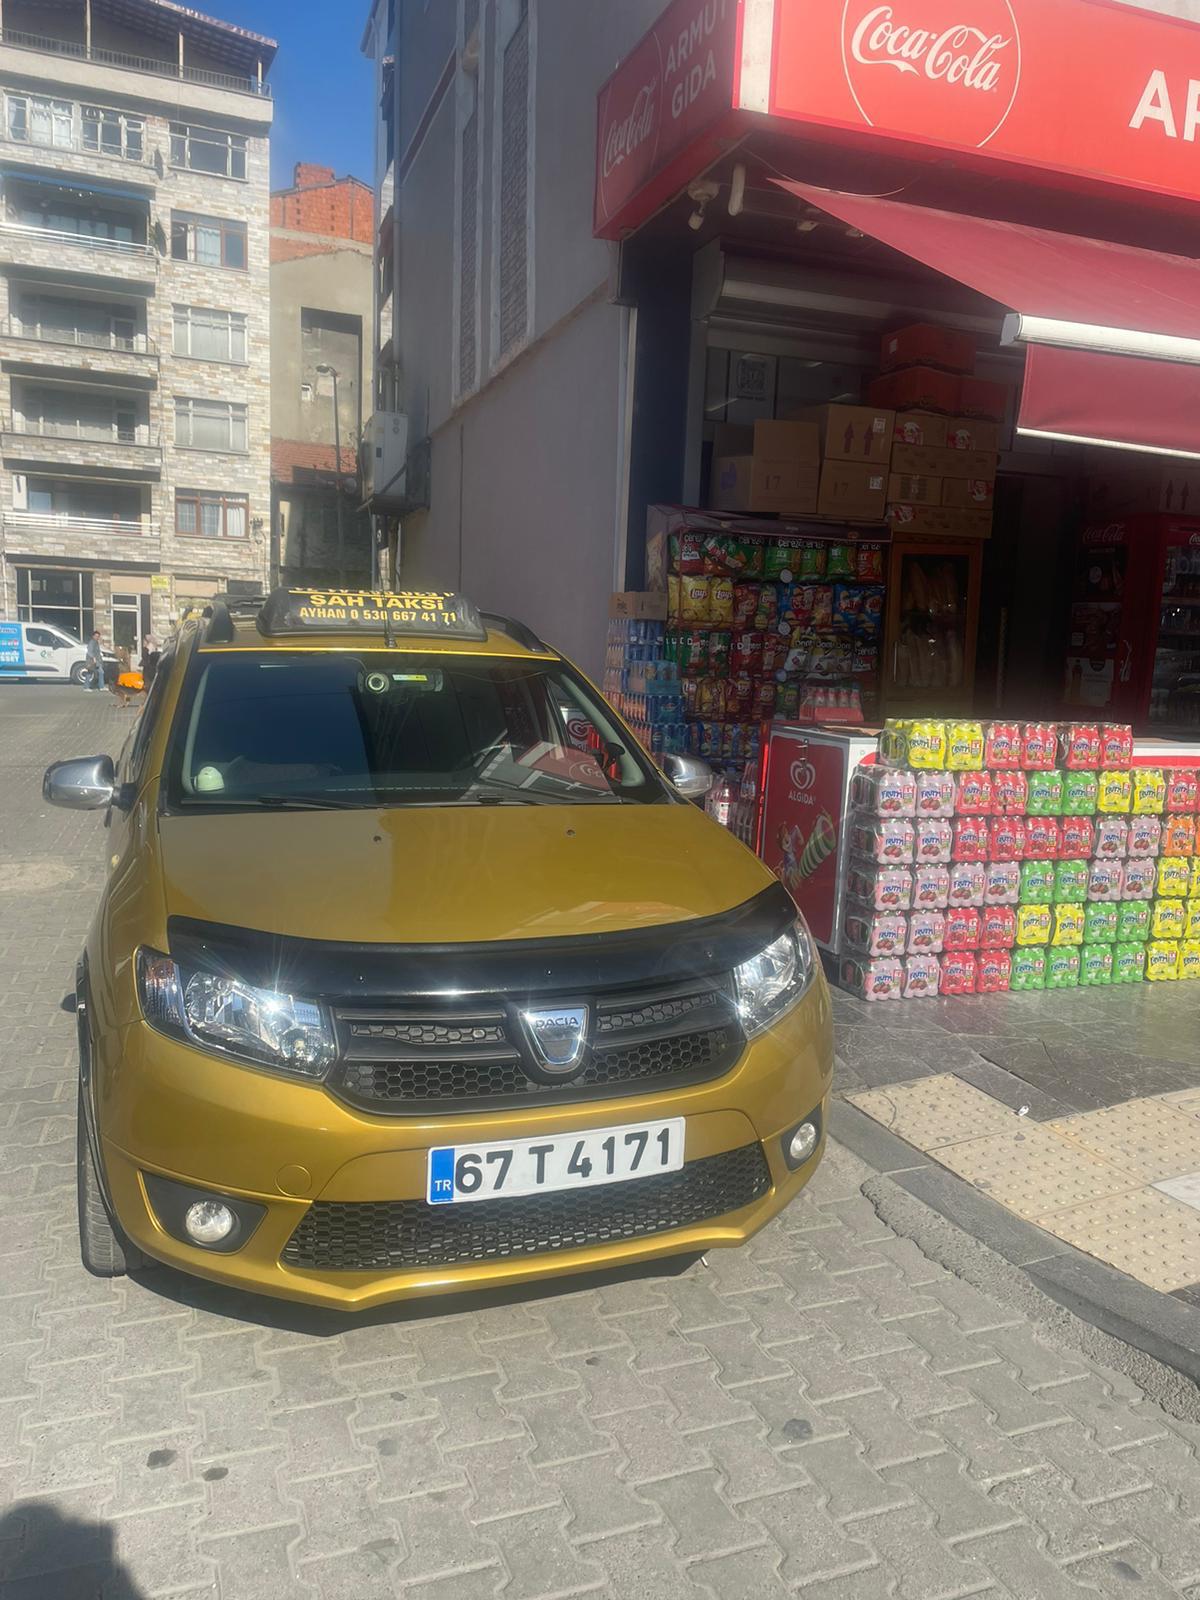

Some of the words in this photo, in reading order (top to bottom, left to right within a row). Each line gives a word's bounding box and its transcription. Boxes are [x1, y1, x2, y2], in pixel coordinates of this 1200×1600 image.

[852, 5, 1012, 91] Coca-Cola
[672, 50, 716, 119] GIDA
[603, 77, 656, 177] Coca-Cola
[299, 607, 346, 619] AYHAN
[351, 609, 359, 620] 0
[363, 609, 388, 621] 530
[393, 610, 417, 621] 667
[421, 611, 436, 622] 41
[441, 611, 457, 623] 71
[310, 595, 364, 608] ŞAH
[535, 1016, 579, 1028] DACIA
[455, 1149, 513, 1194] 67
[528, 1144, 554, 1185] T
[567, 1127, 670, 1178] 4171
[434, 1179, 451, 1192] TR
